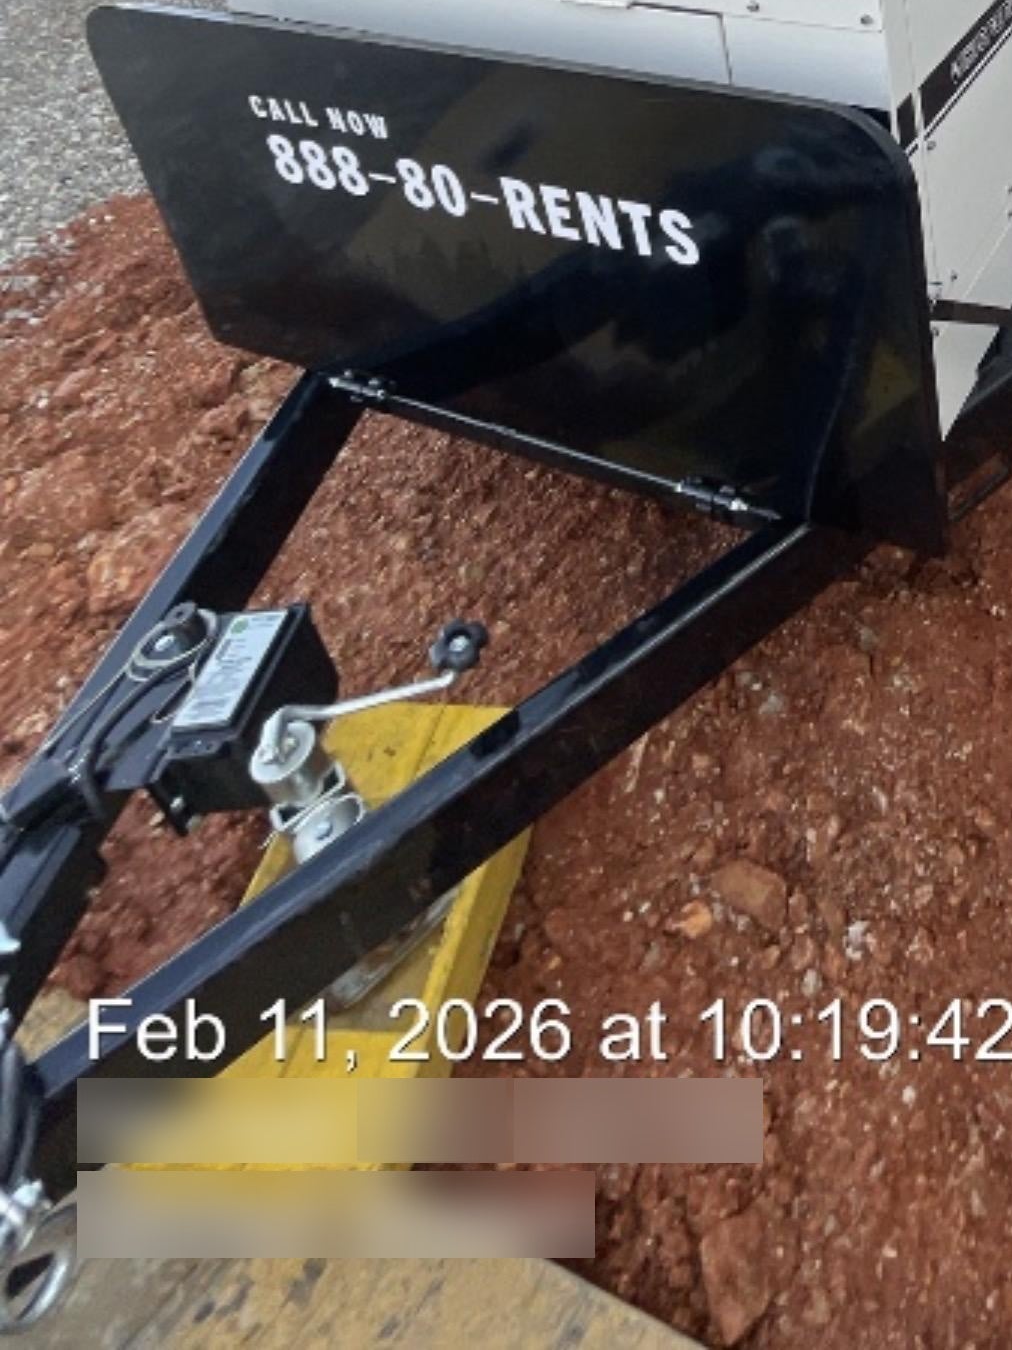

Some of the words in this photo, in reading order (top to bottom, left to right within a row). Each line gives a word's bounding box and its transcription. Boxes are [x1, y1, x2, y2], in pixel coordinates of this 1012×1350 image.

[248, 94, 318, 128] CALL
[326, 106, 389, 140] NOW
[265, 133, 700, 266] 888-80-RENTS
